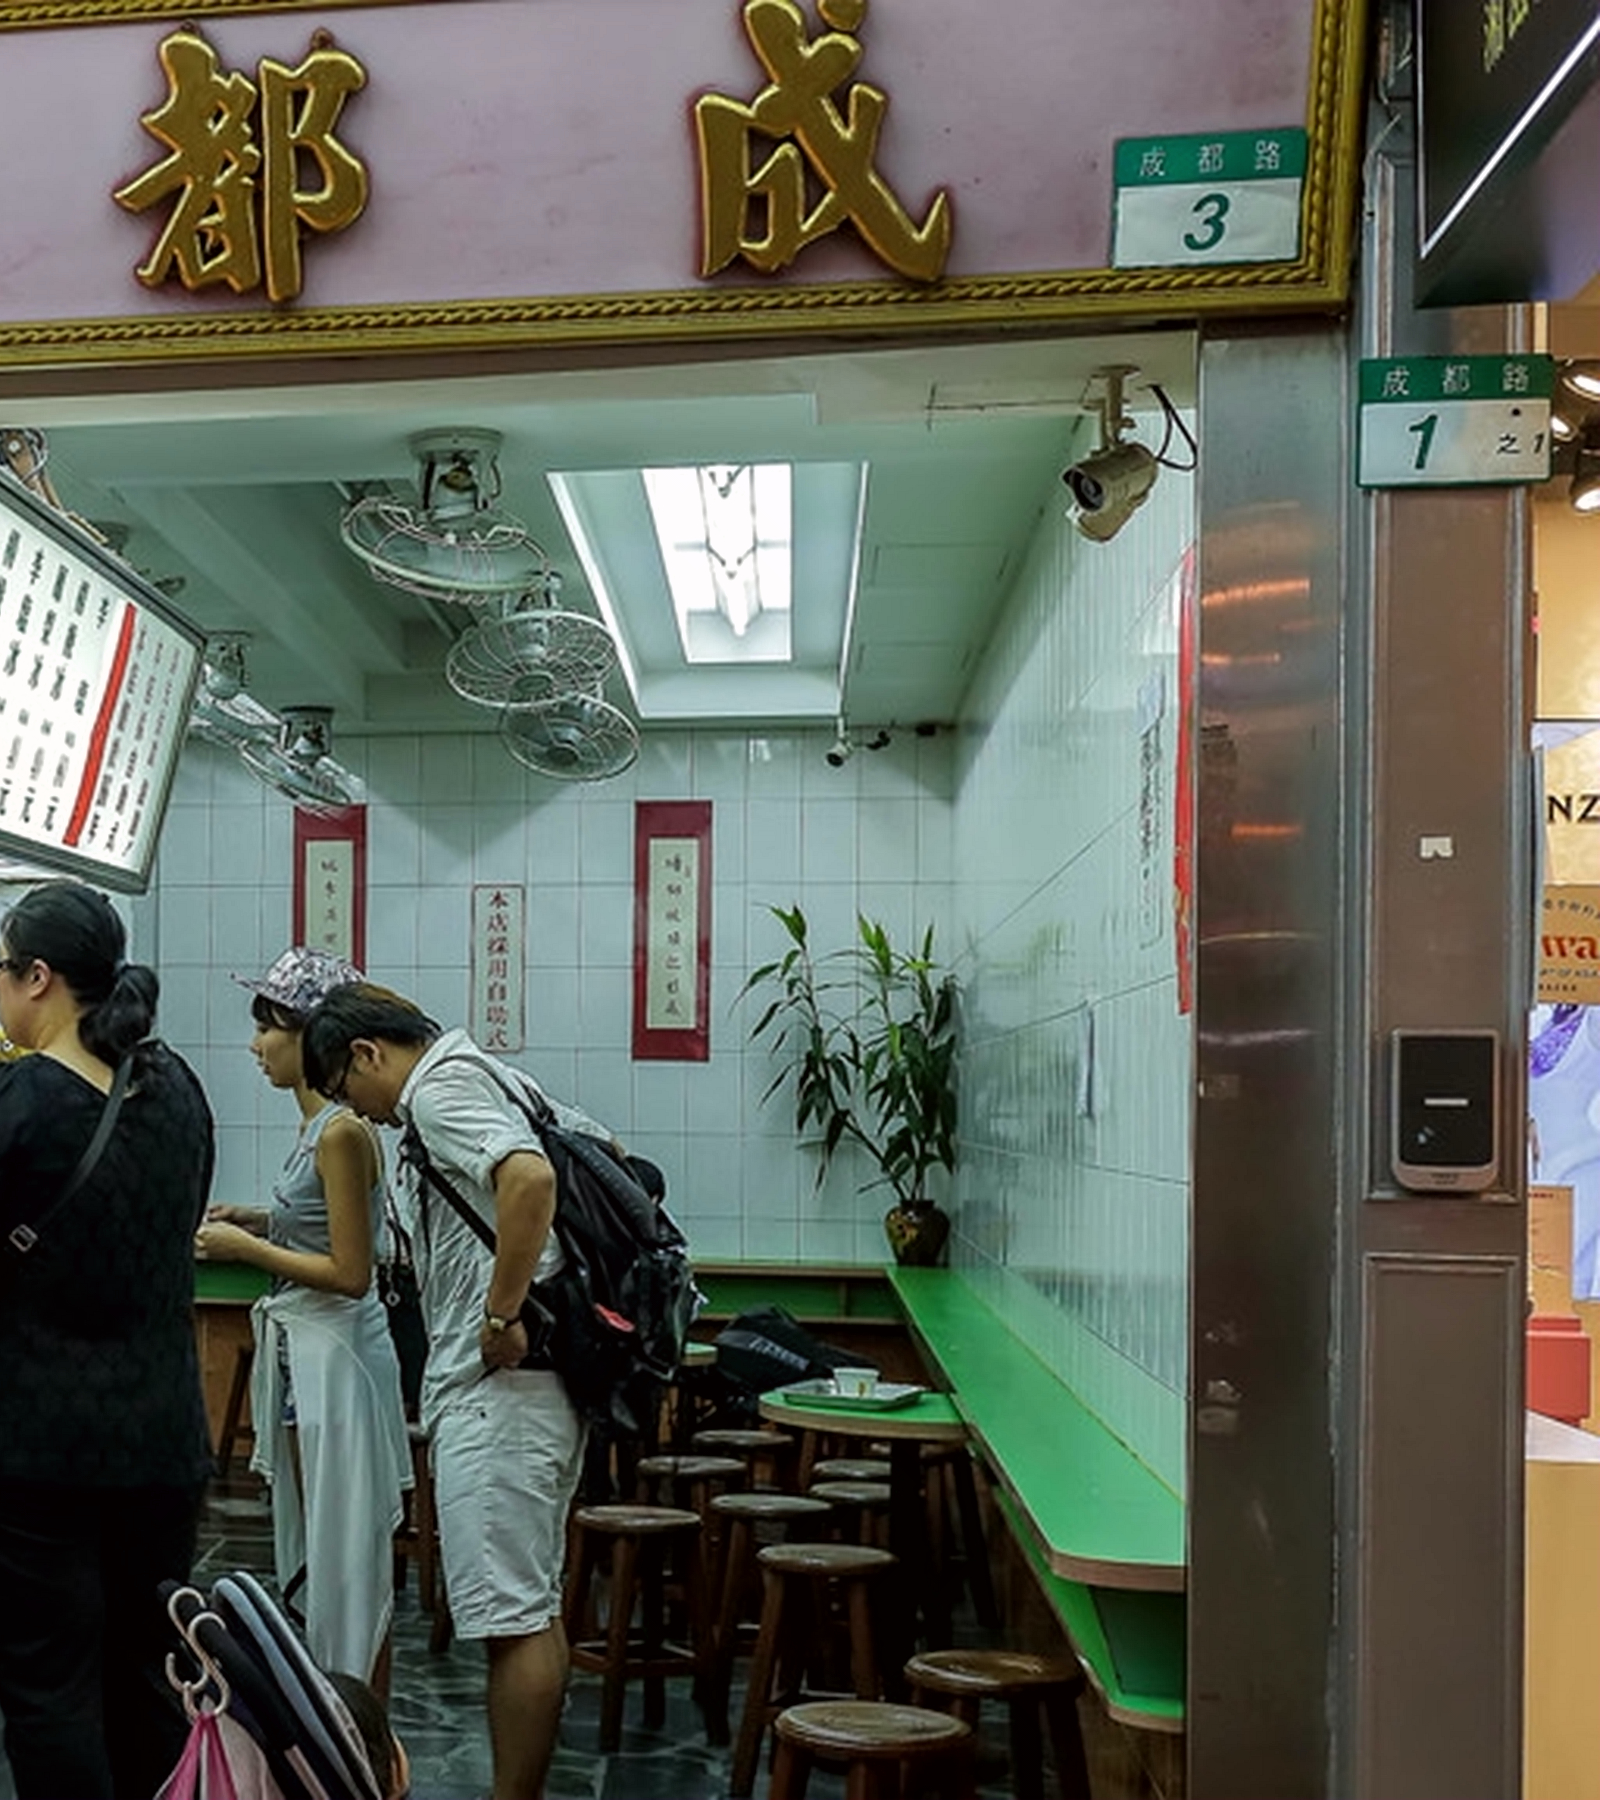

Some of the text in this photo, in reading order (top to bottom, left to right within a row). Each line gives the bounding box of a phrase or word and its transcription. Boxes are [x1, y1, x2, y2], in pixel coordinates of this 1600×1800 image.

[1139, 140, 1280, 177] 成都路
[1183, 192, 1230, 251] 3
[1381, 363, 1529, 396] 成都路
[1408, 413, 1438, 470] 1
